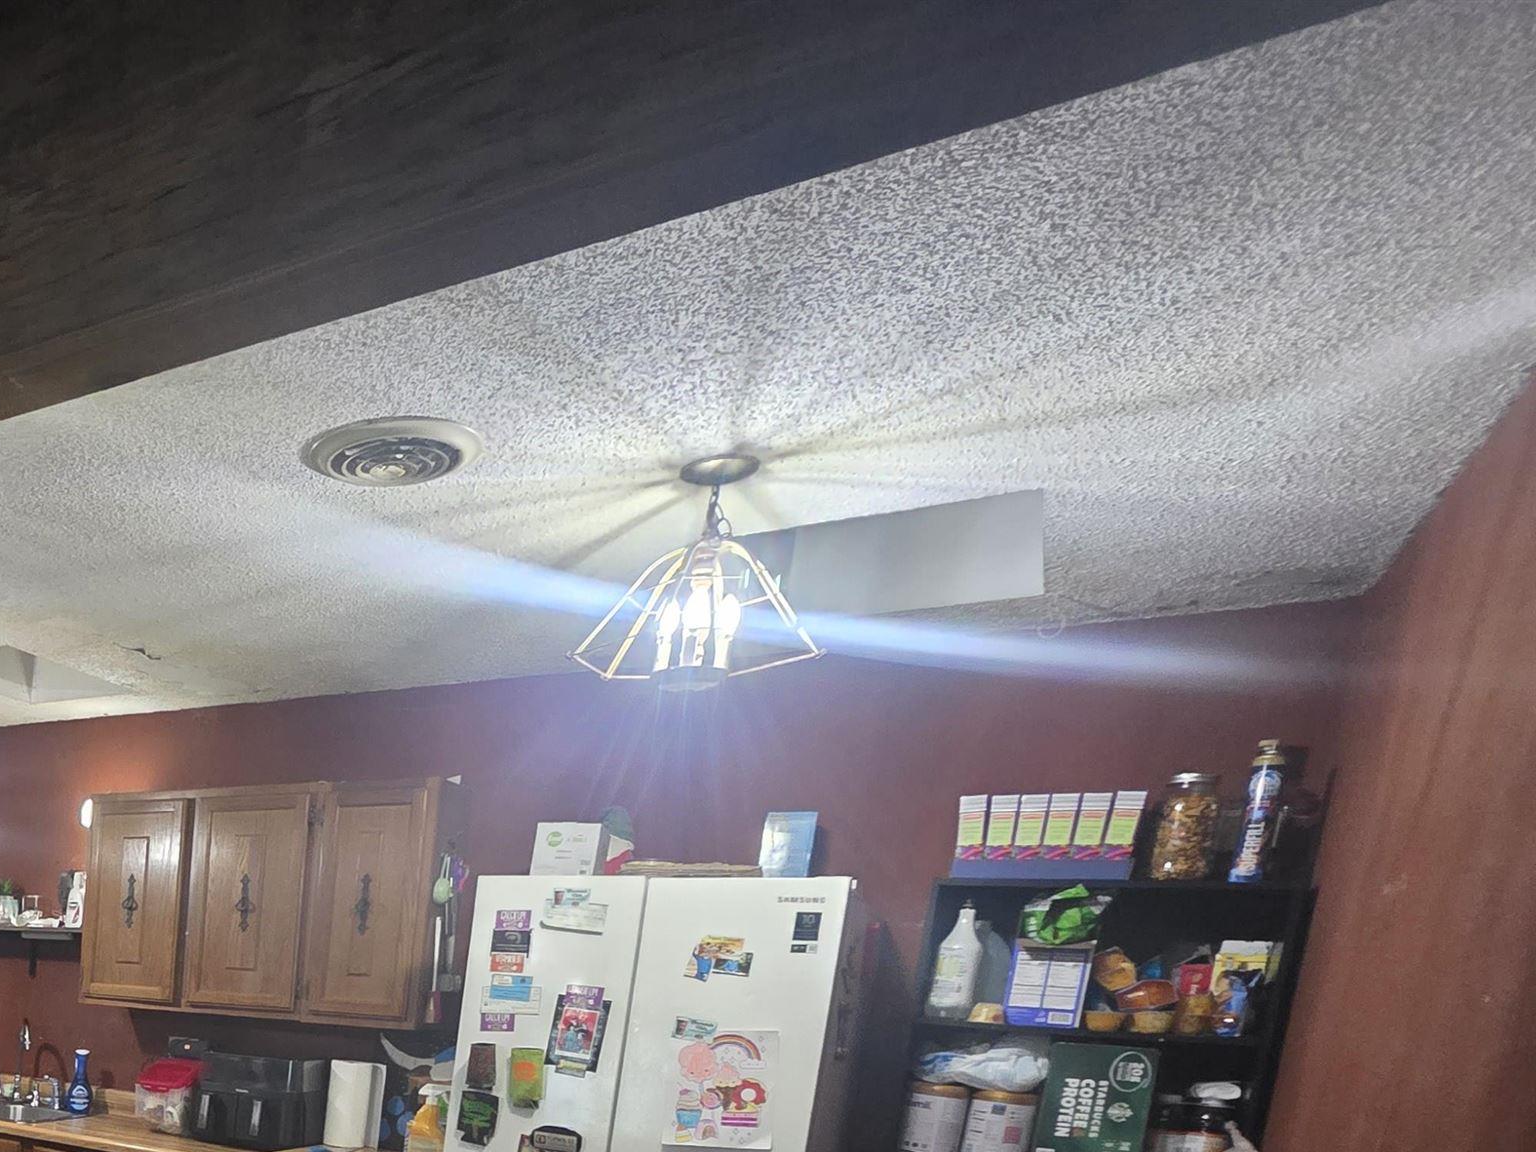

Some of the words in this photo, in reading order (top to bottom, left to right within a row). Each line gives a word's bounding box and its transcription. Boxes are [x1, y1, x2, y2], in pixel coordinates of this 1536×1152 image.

[777, 896, 826, 904] SAMSUNG
[1054, 1077, 1080, 1137] PROTEIN
[1072, 1078, 1096, 1128] COFFEE
[1088, 1080, 1109, 1138] STARBUCKS
